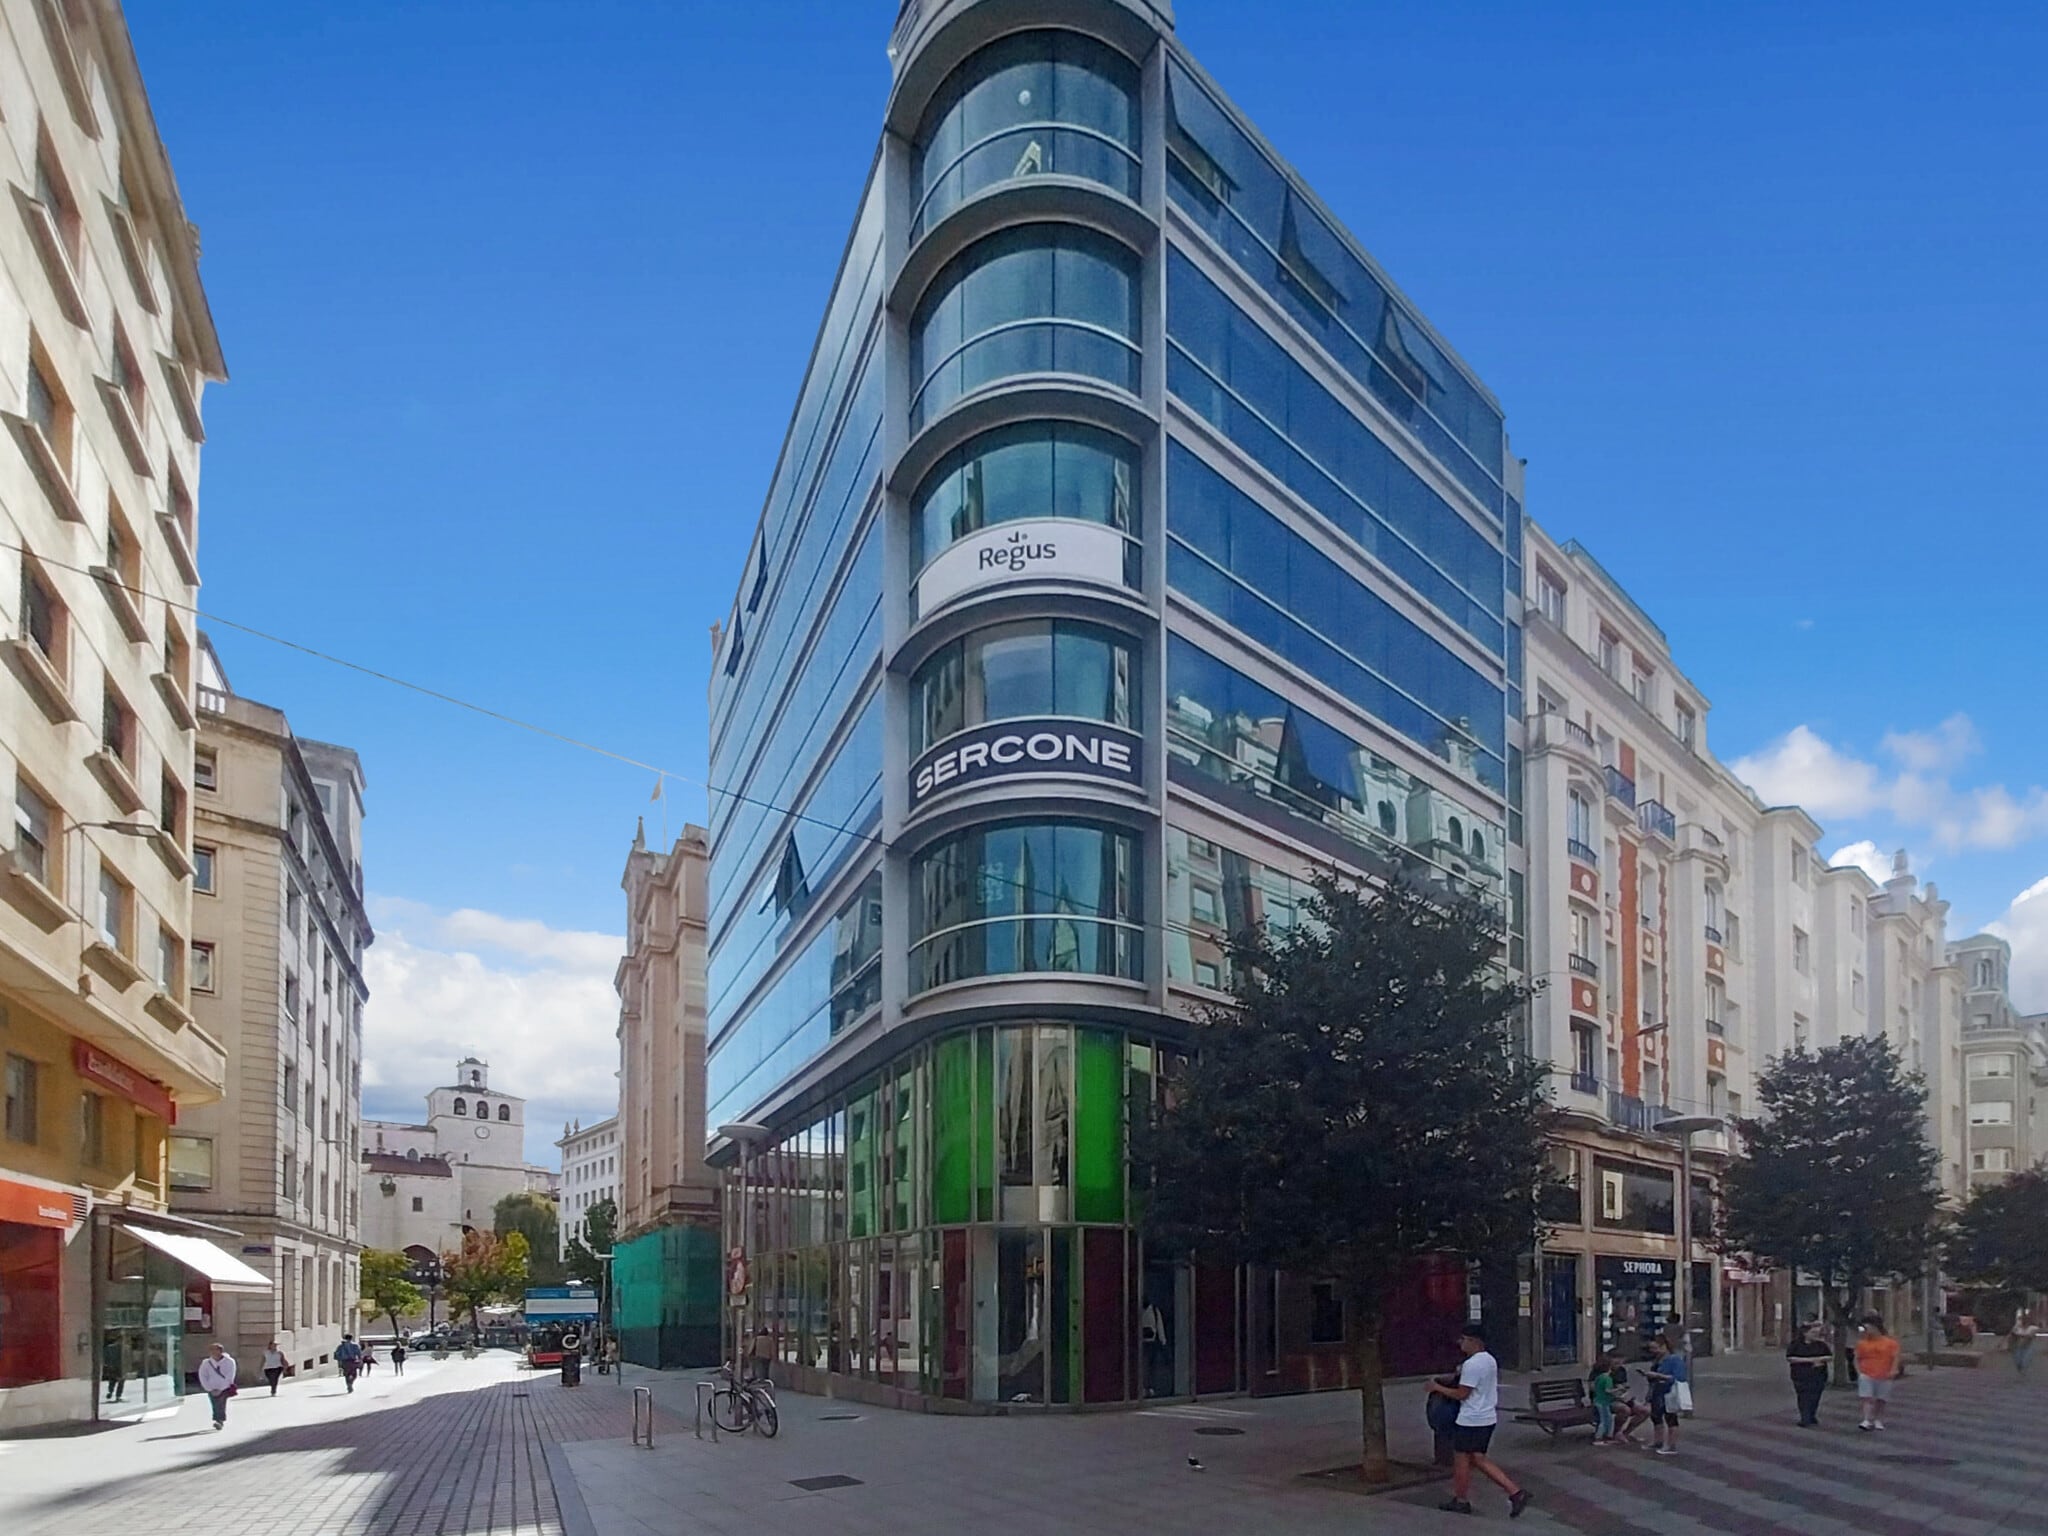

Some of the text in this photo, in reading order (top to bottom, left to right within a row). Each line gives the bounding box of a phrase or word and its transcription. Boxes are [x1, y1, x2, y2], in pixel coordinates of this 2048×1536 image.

[978, 542, 1057, 572] Regus
[915, 732, 1132, 799] SERCONE
[1623, 1261, 1663, 1274] SEPHORA
